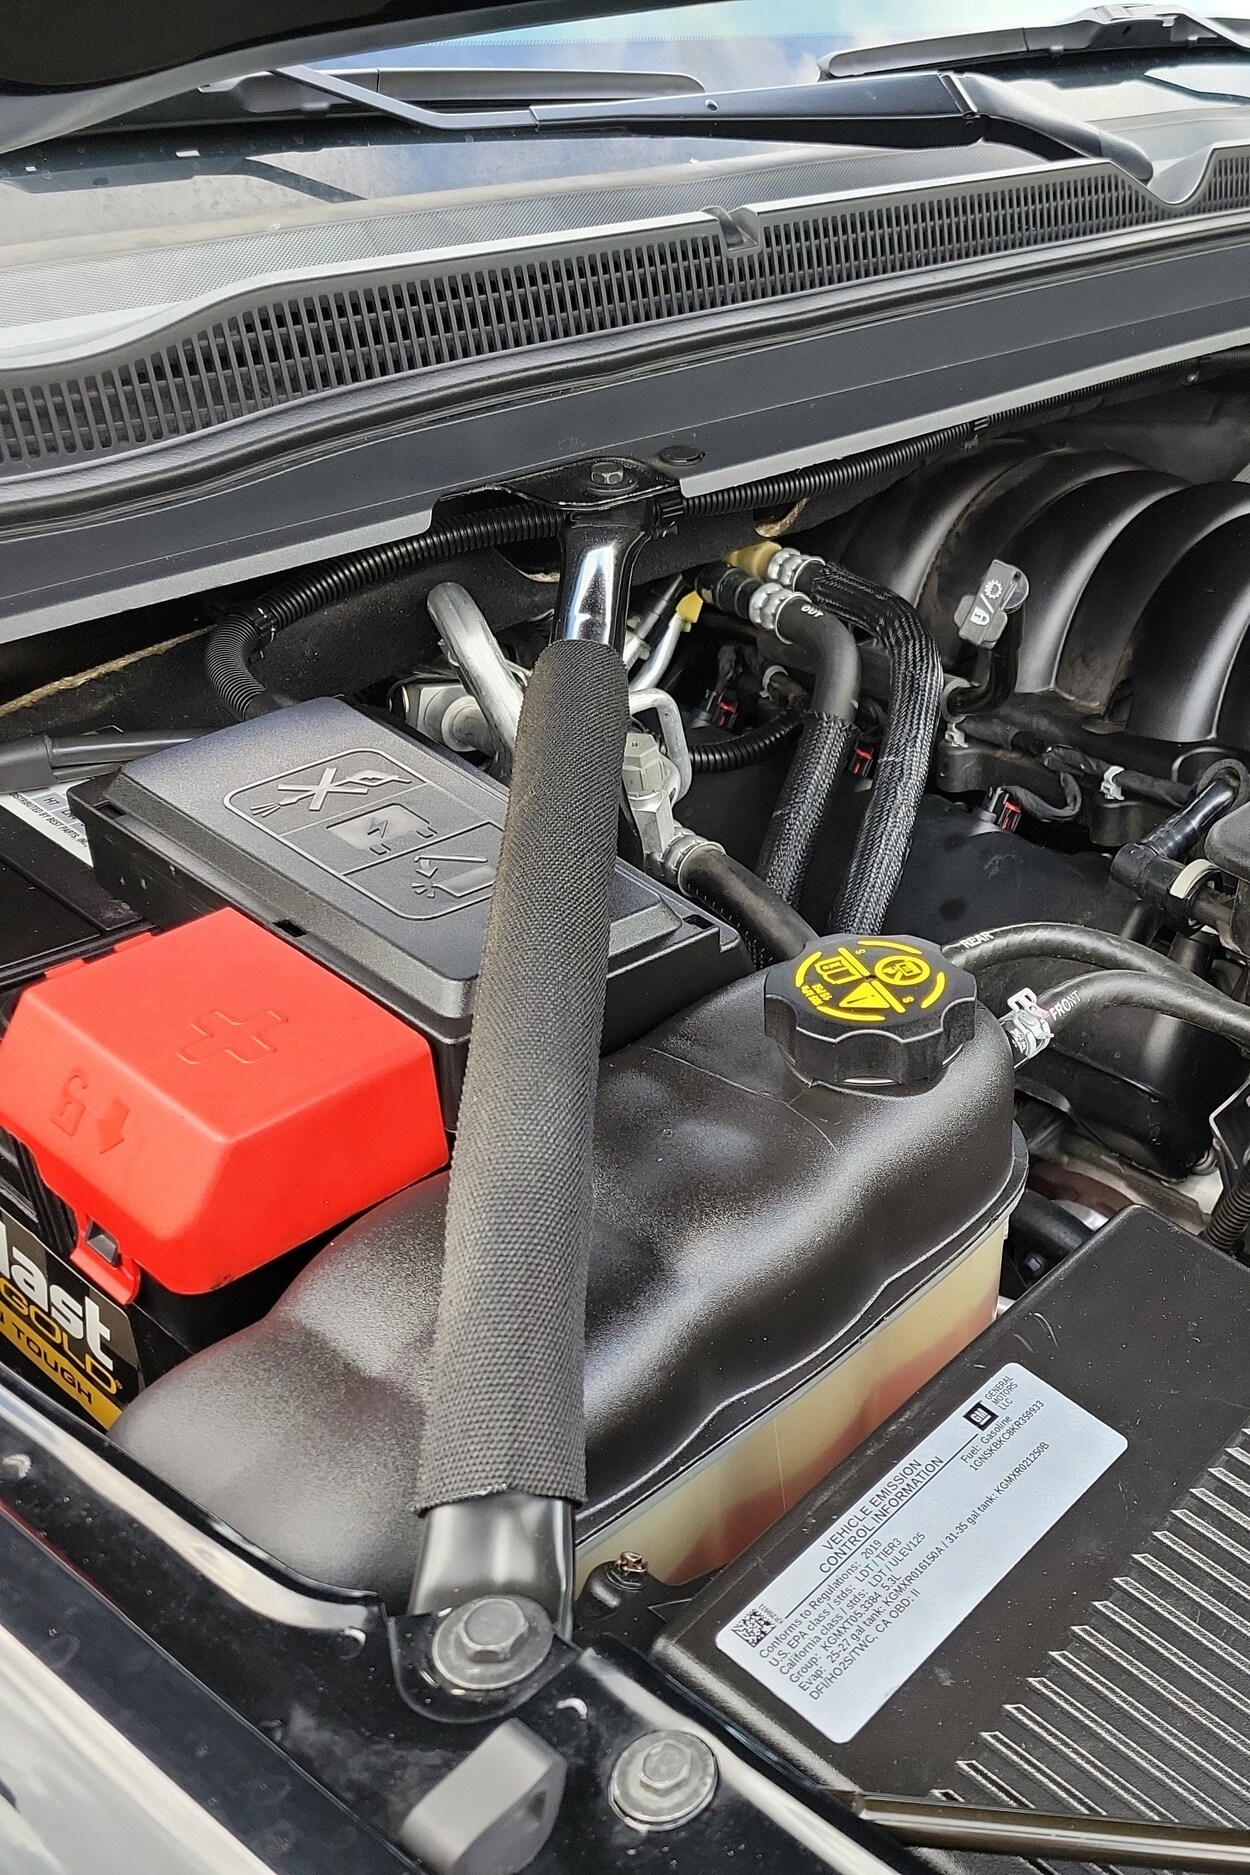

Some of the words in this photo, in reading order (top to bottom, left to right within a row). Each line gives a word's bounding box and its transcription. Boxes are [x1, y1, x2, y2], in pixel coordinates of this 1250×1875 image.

[801, 604, 824, 618] OUT
[960, 931, 995, 949] REAR
[1048, 989, 1082, 1021] FRONT
[12, 1323, 93, 1405] TOUGH
[984, 1375, 1013, 1400] GENERAL
[990, 1381, 1017, 1405] MOTORS
[997, 1397, 1013, 1410] LLC
[959, 1445, 981, 1463] Fuel:
[980, 1415, 1012, 1444] Gasoline
[969, 1400, 1044, 1471] 1GNSKBKC8KR359933
[819, 1524, 875, 1573] CONTROL
[870, 1455, 944, 1523] INFORMATION
[821, 1505, 873, 1549] VEHICLE
[868, 1458, 922, 1507] EMISSION
[759, 1618, 802, 1658] Conforms
[799, 1609, 811, 1619] to
[808, 1561, 861, 1610] Regulations:
[860, 1539, 882, 1559] 2019
[768, 1649, 790, 1666] U.S.
[786, 1630, 809, 1649] EPA
[807, 1608, 830, 1631] class
[833, 1584, 855, 1605] stds:
[854, 1563, 874, 1582] LDT
[874, 1537, 901, 1561] TIER3
[779, 1635, 822, 1674] California
[820, 1613, 843, 1635] class
[846, 1588, 868, 1610] stds:
[867, 1568, 887, 1587] LDT
[887, 1531, 925, 1566] ULEV125
[797, 1664, 826, 1691] Evap:
[826, 1637, 851, 1663] 25-27
[850, 1624, 865, 1642] gal
[862, 1605, 885, 1626] tank:
[881, 1546, 945, 1606] KGMXR016150A
[944, 1521, 968, 1543] 31-35
[966, 1509, 980, 1525] gal
[976, 1493, 998, 1512] tank:
[993, 1441, 1049, 1494] KGMXR021250B
[789, 1653, 821, 1686] Group:
[820, 1591, 882, 1651] KGMXT05.3384
[880, 1574, 902, 1591] 5.3L
[808, 1634, 879, 1700] DFI/HO2S/TWC,
[875, 1618, 892, 1632] CA
[888, 1596, 914, 1618] OBD:
